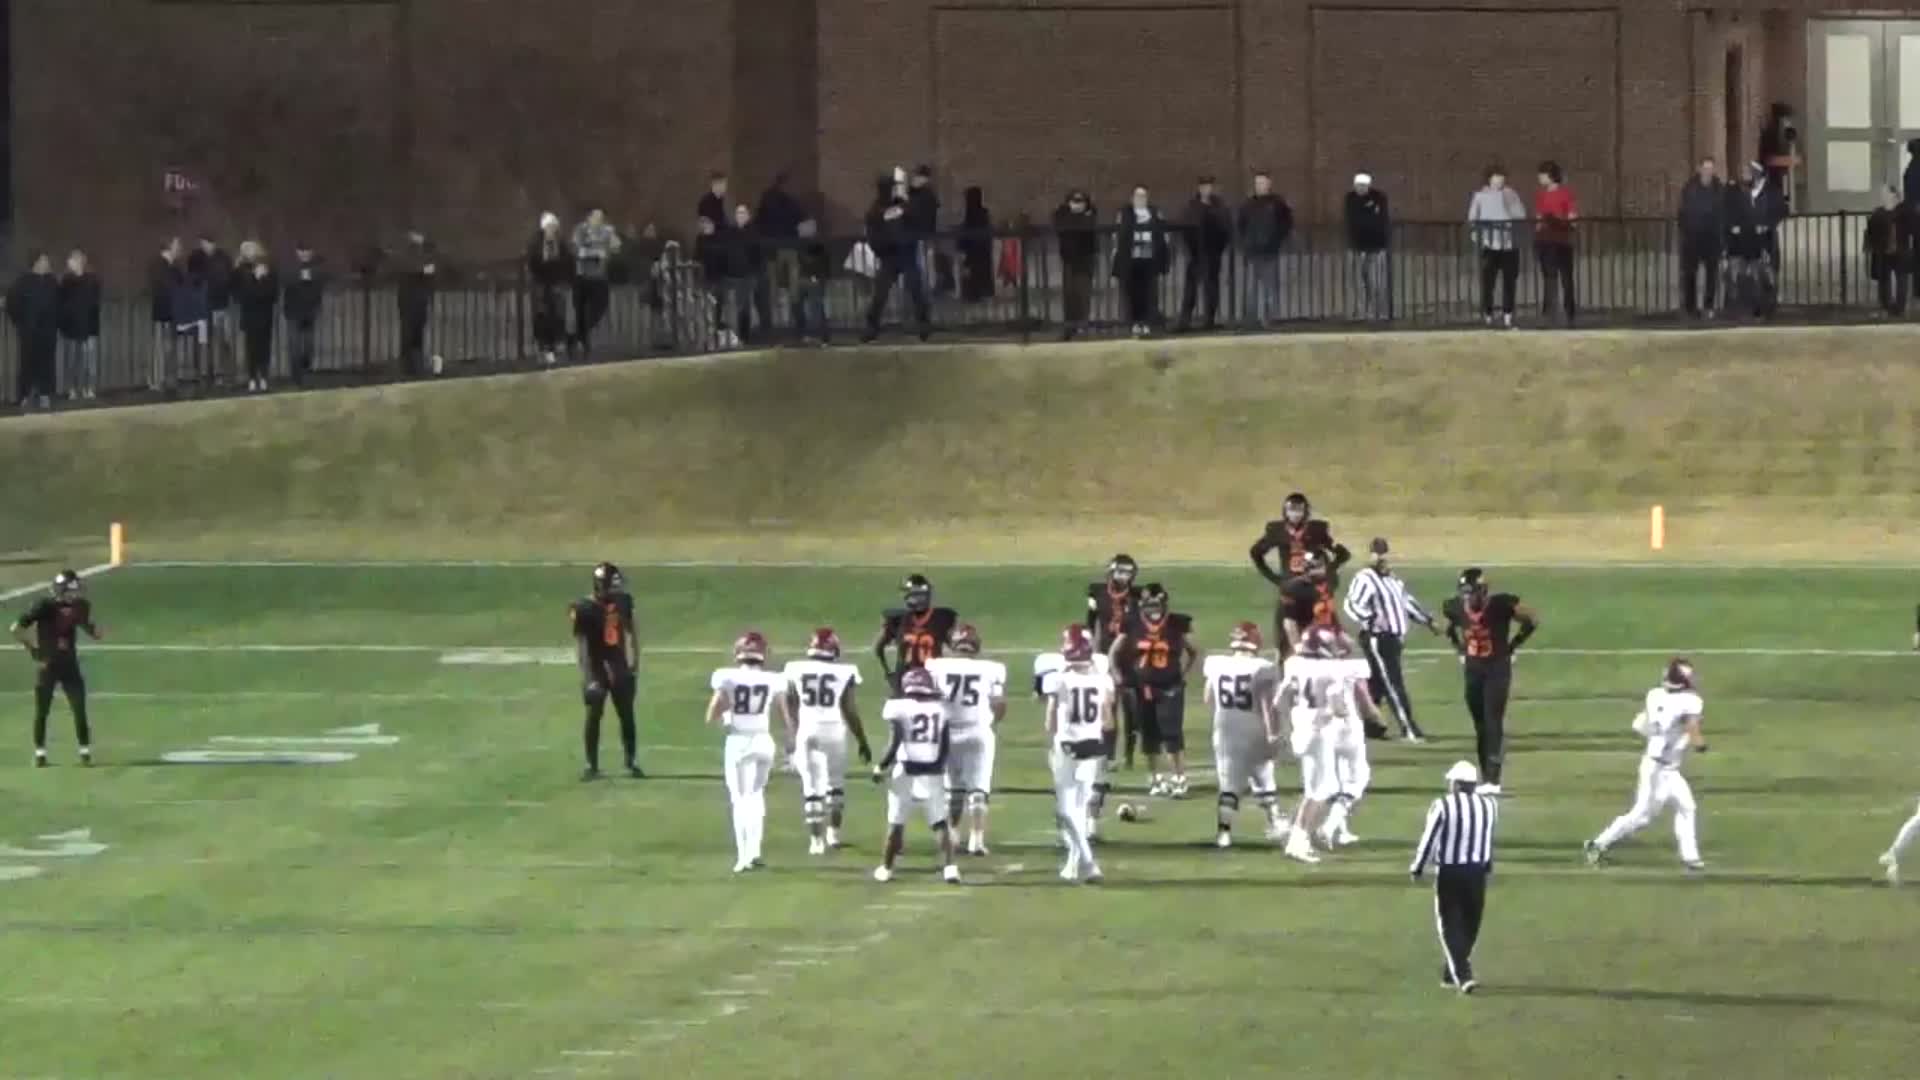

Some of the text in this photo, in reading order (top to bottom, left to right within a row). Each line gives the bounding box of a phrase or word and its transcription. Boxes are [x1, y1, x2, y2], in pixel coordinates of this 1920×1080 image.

[733, 684, 769, 714] 87
[801, 673, 837, 707] 56
[945, 673, 980, 706] 75
[1071, 687, 1099, 723] 16
[1218, 674, 1253, 710] 65
[911, 713, 940, 743] 21
